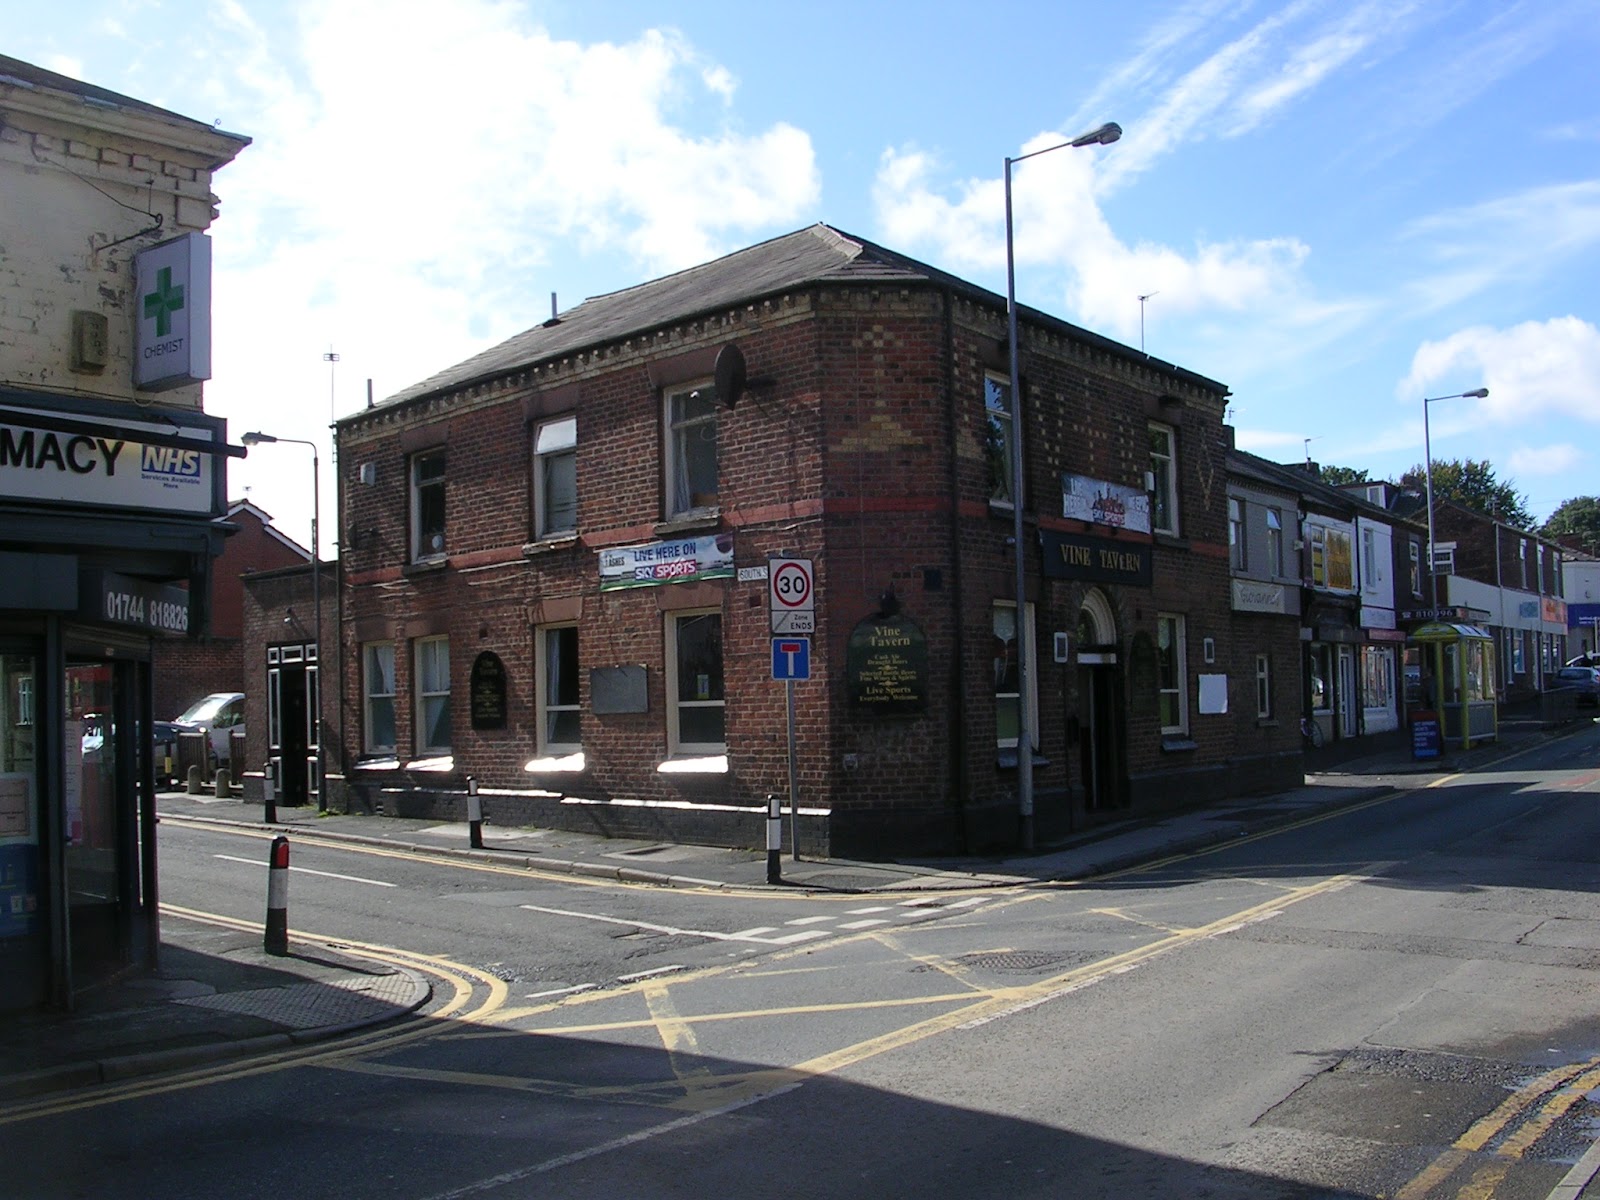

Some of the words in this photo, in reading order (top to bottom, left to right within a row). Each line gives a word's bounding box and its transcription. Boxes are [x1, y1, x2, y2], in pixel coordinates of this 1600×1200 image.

[144, 338, 184, 359] CHEMIST
[0, 428, 125, 476] MACY
[143, 446, 200, 475] NHS
[141, 473, 169, 482] Services
[171, 476, 201, 485] Available
[634, 549, 653, 562] LIVE
[656, 545, 680, 559] HERE
[683, 542, 697, 556] ON
[1060, 544, 1091, 567] VINE
[1099, 549, 1140, 573] TAVERN
[635, 567, 655, 579] SKY
[656, 561, 696, 578] SPORTS
[740, 568, 761, 580] SOUTH
[779, 576, 805, 594] 30
[107, 591, 144, 623] 01744
[150, 600, 188, 631] 818826
[791, 622, 812, 630] ENDS
[875, 626, 900, 636] Vine
[870, 636, 910, 646] Tavern
[866, 686, 884, 695] Live
[885, 686, 911, 695] Sports
